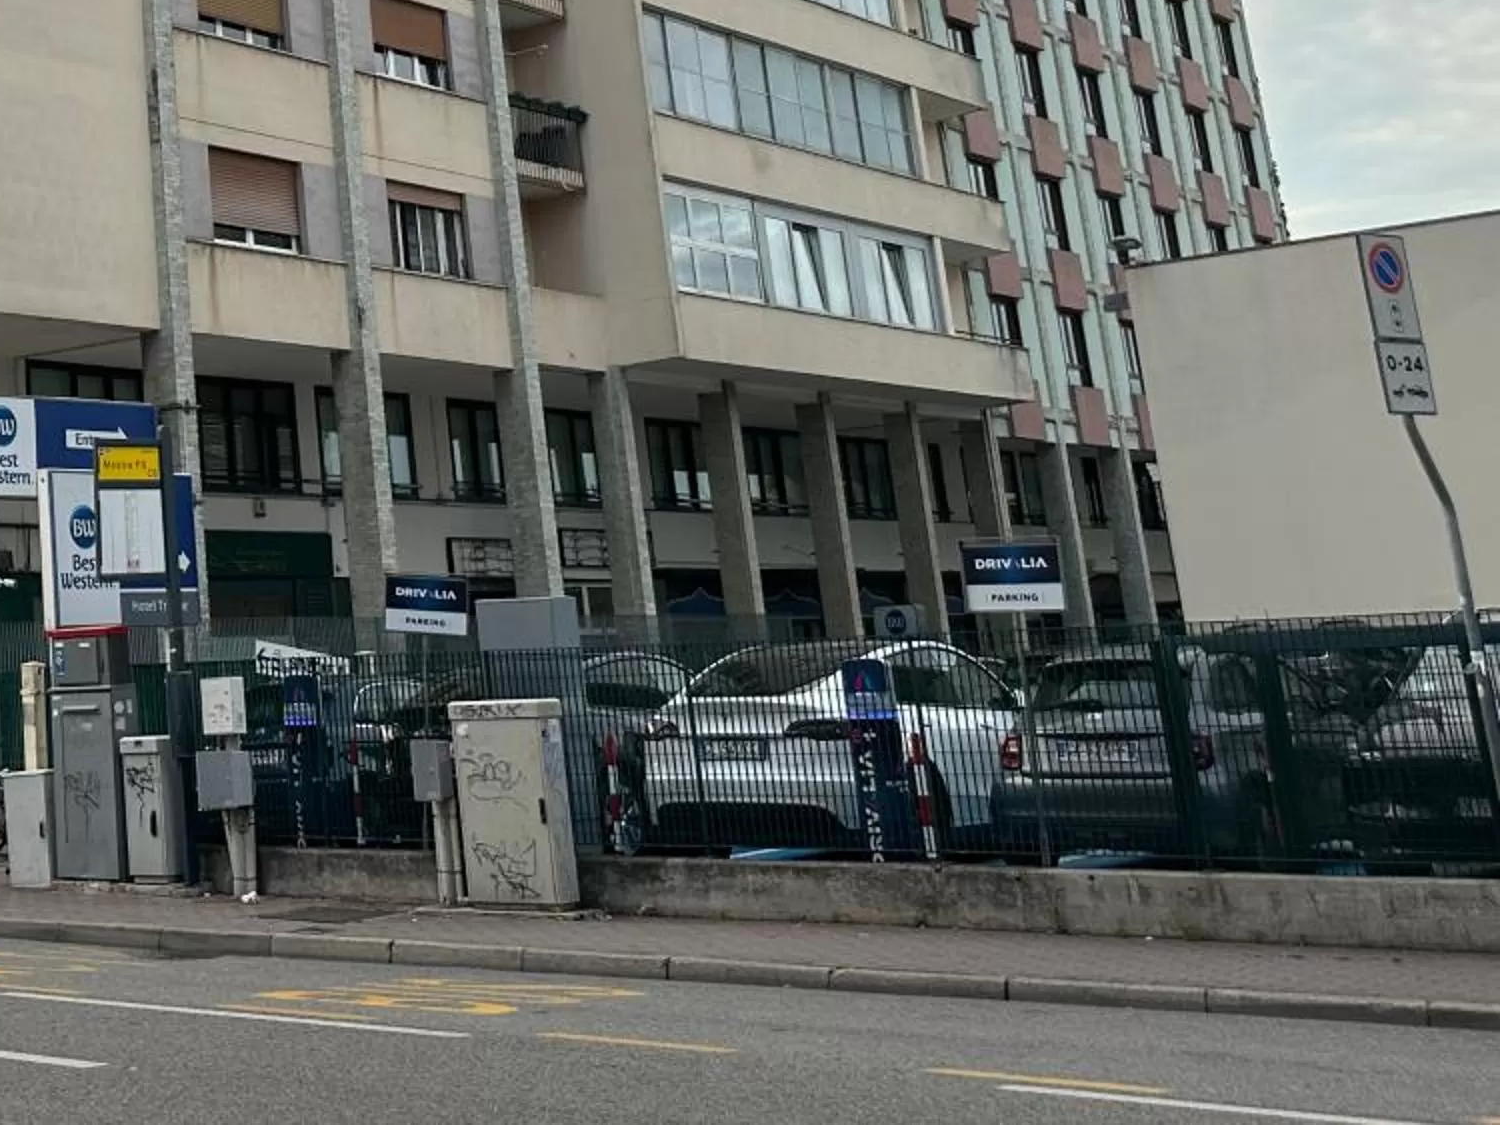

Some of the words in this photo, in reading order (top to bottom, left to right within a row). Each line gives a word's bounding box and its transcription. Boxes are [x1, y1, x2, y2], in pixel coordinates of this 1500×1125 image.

[1385, 354, 1424, 372] 0-24
[72, 554, 96, 572] Bes
[990, 593, 1039, 602] PARKING
